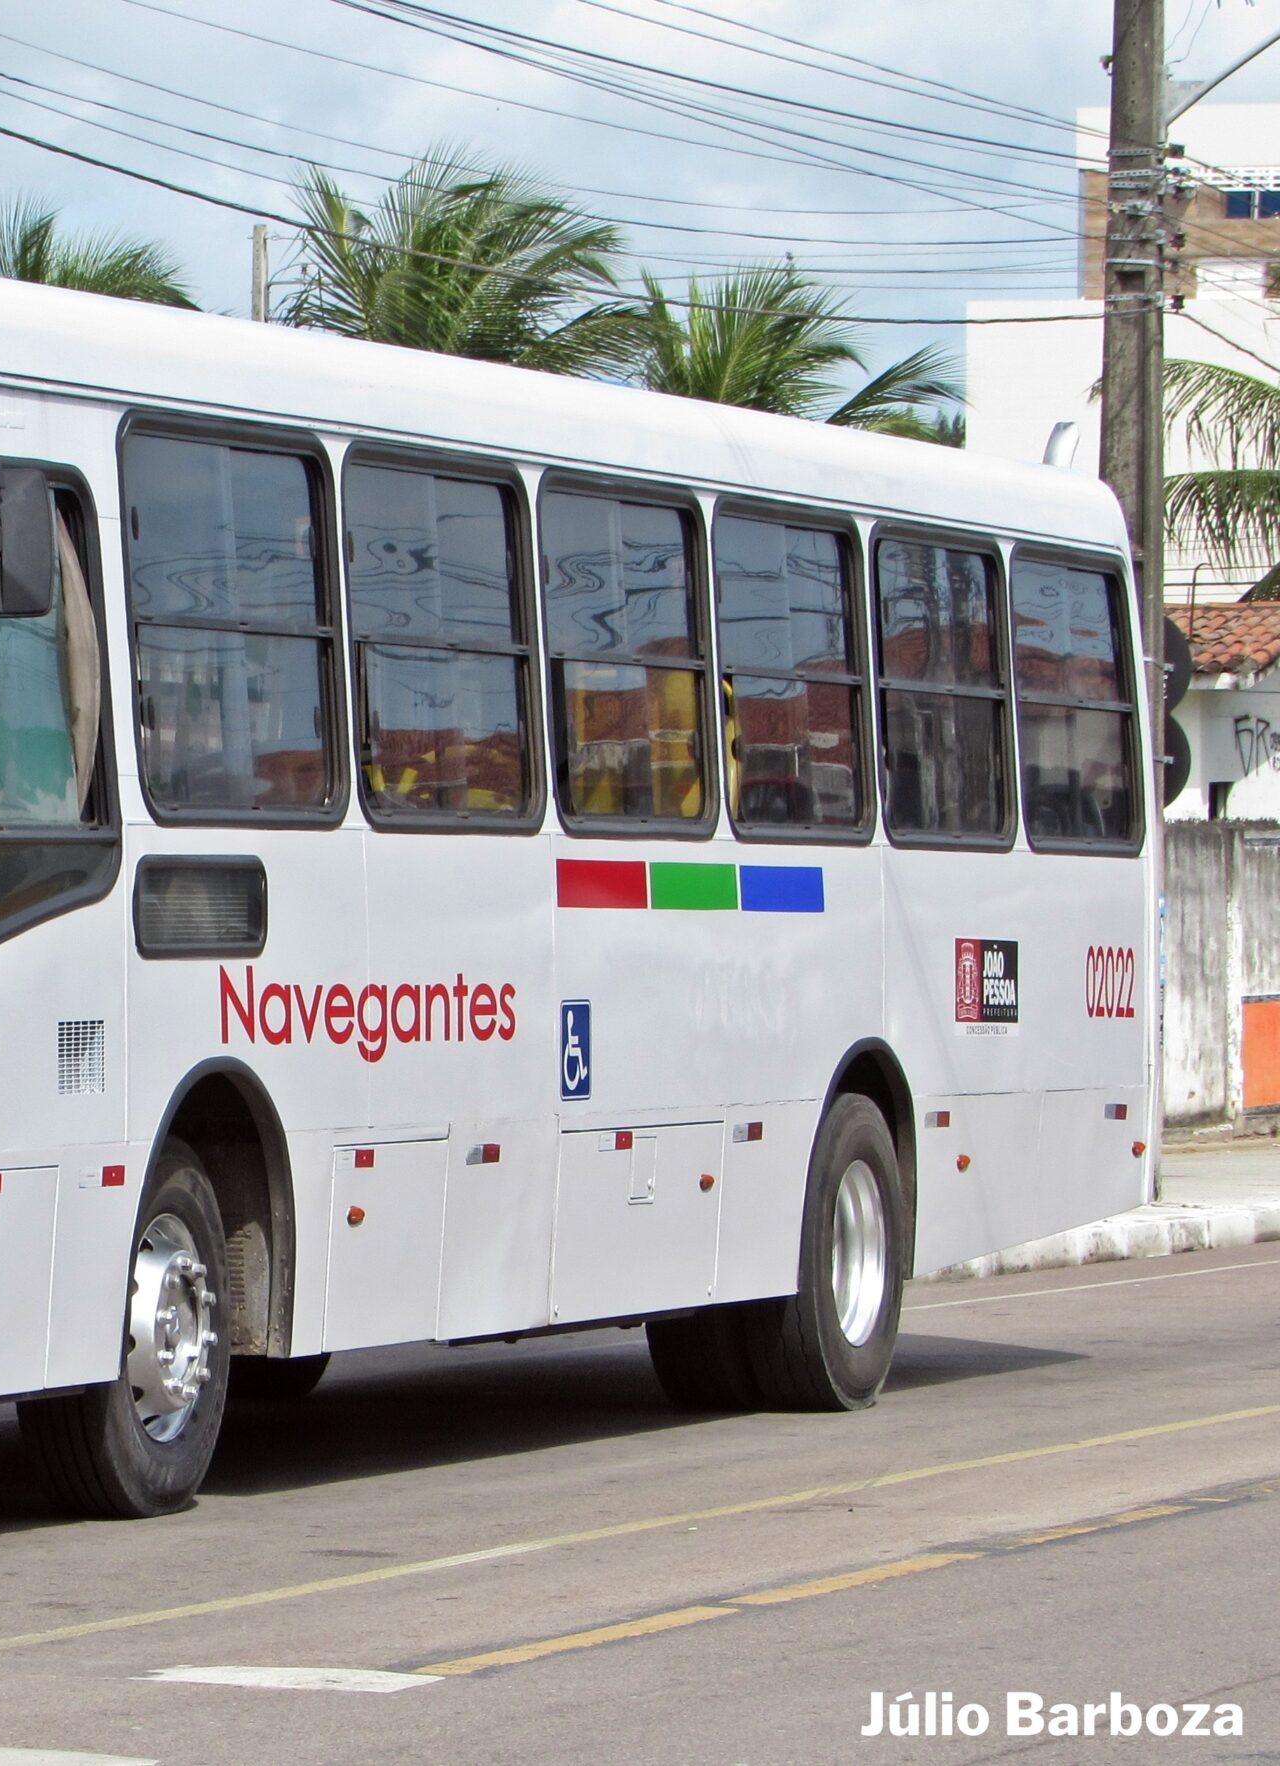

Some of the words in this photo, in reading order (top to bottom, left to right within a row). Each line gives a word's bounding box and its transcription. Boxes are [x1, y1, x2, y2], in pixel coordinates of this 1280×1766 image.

[983, 944, 1005, 978] JOÃO
[983, 979, 1016, 1006] PESSOA
[1086, 945, 1135, 1019] 02022
[219, 964, 517, 1063] Navegantes
[983, 1008, 1017, 1017] PREFEITURA
